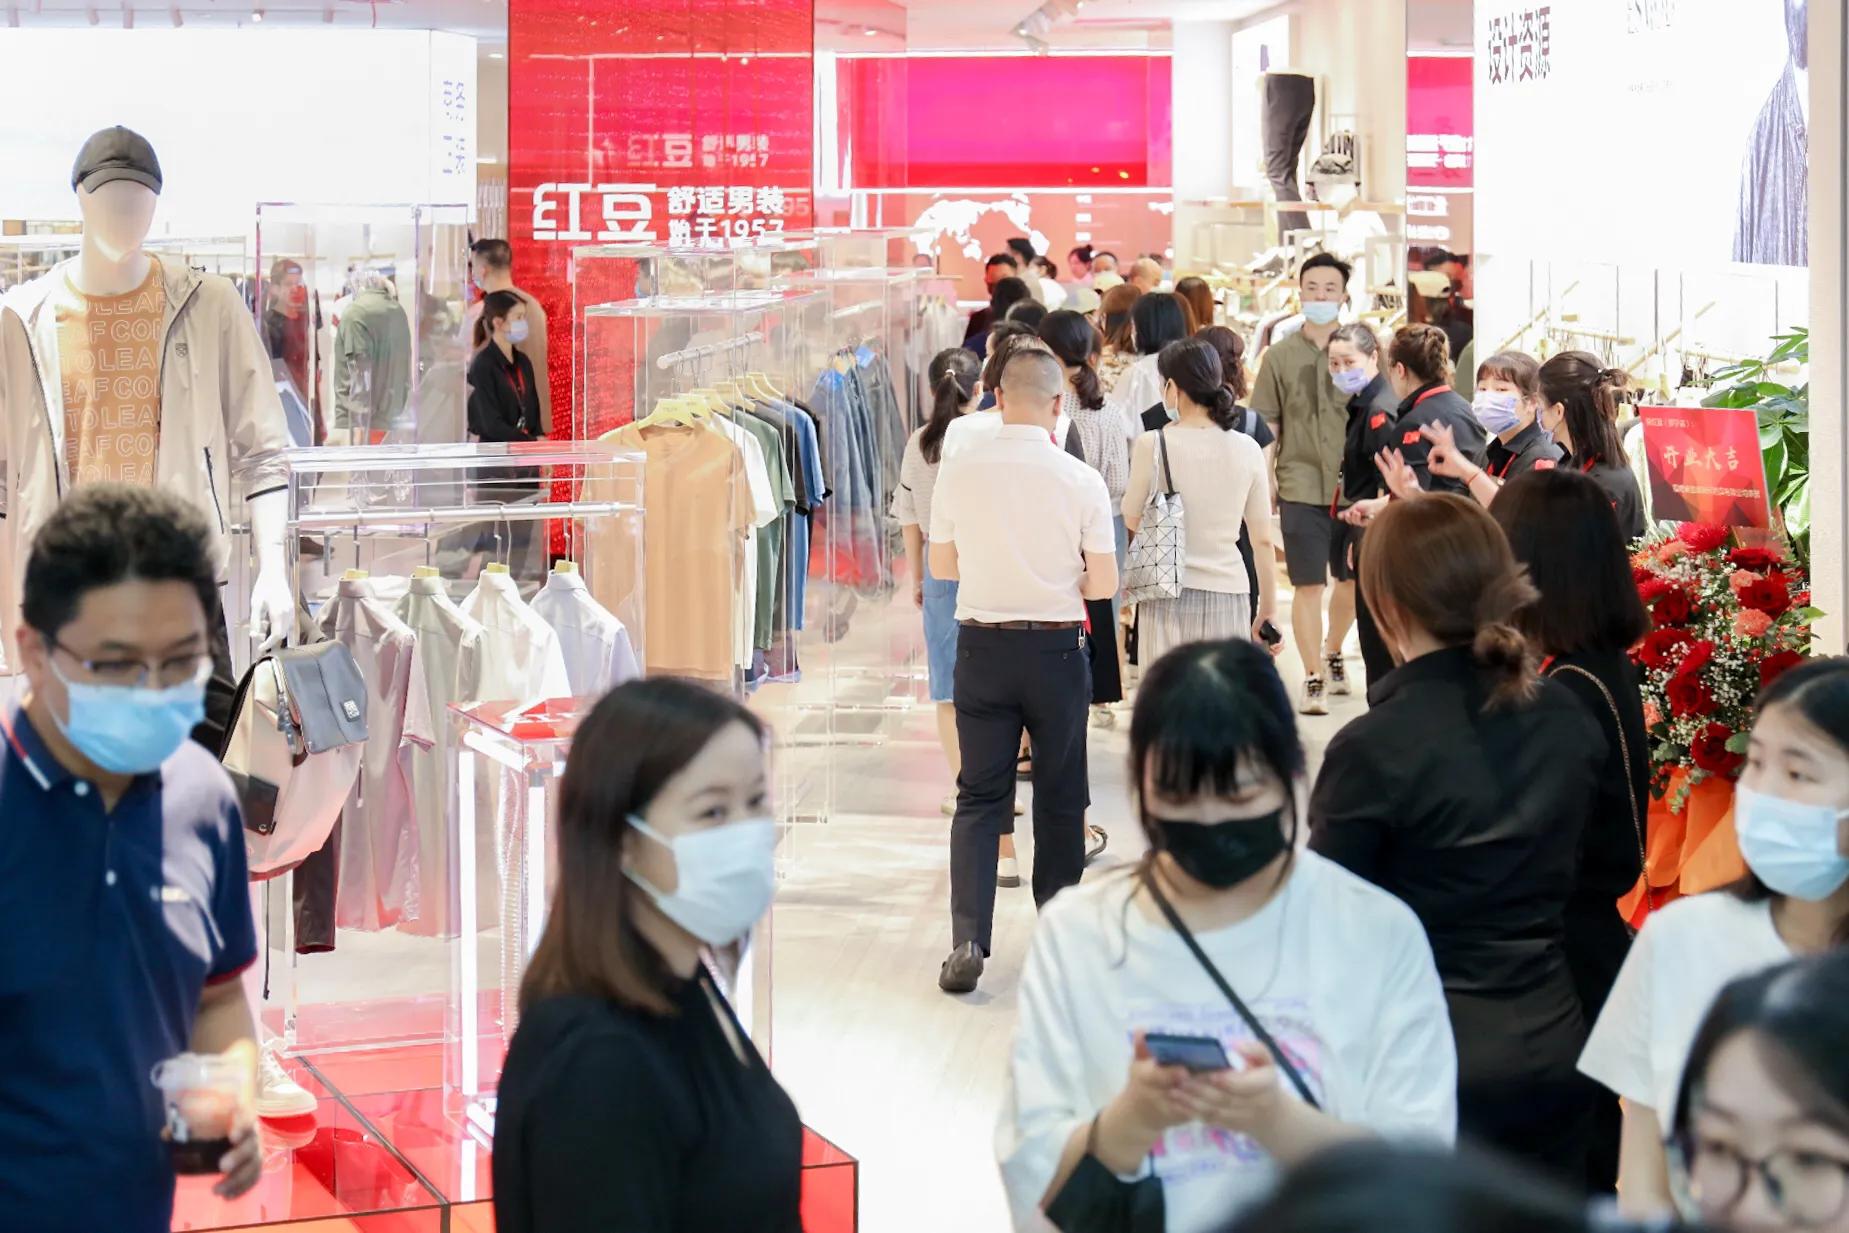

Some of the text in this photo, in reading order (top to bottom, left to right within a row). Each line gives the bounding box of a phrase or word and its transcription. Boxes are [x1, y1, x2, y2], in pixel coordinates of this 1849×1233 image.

[1488, 6, 1550, 84] 设计资源
[533, 182, 657, 240] 红豆
[667, 186, 785, 215] 舒适男装
[98, 346, 158, 371] LEA
[101, 404, 160, 430] LEA
[1663, 445, 1739, 471] 开业大吉
